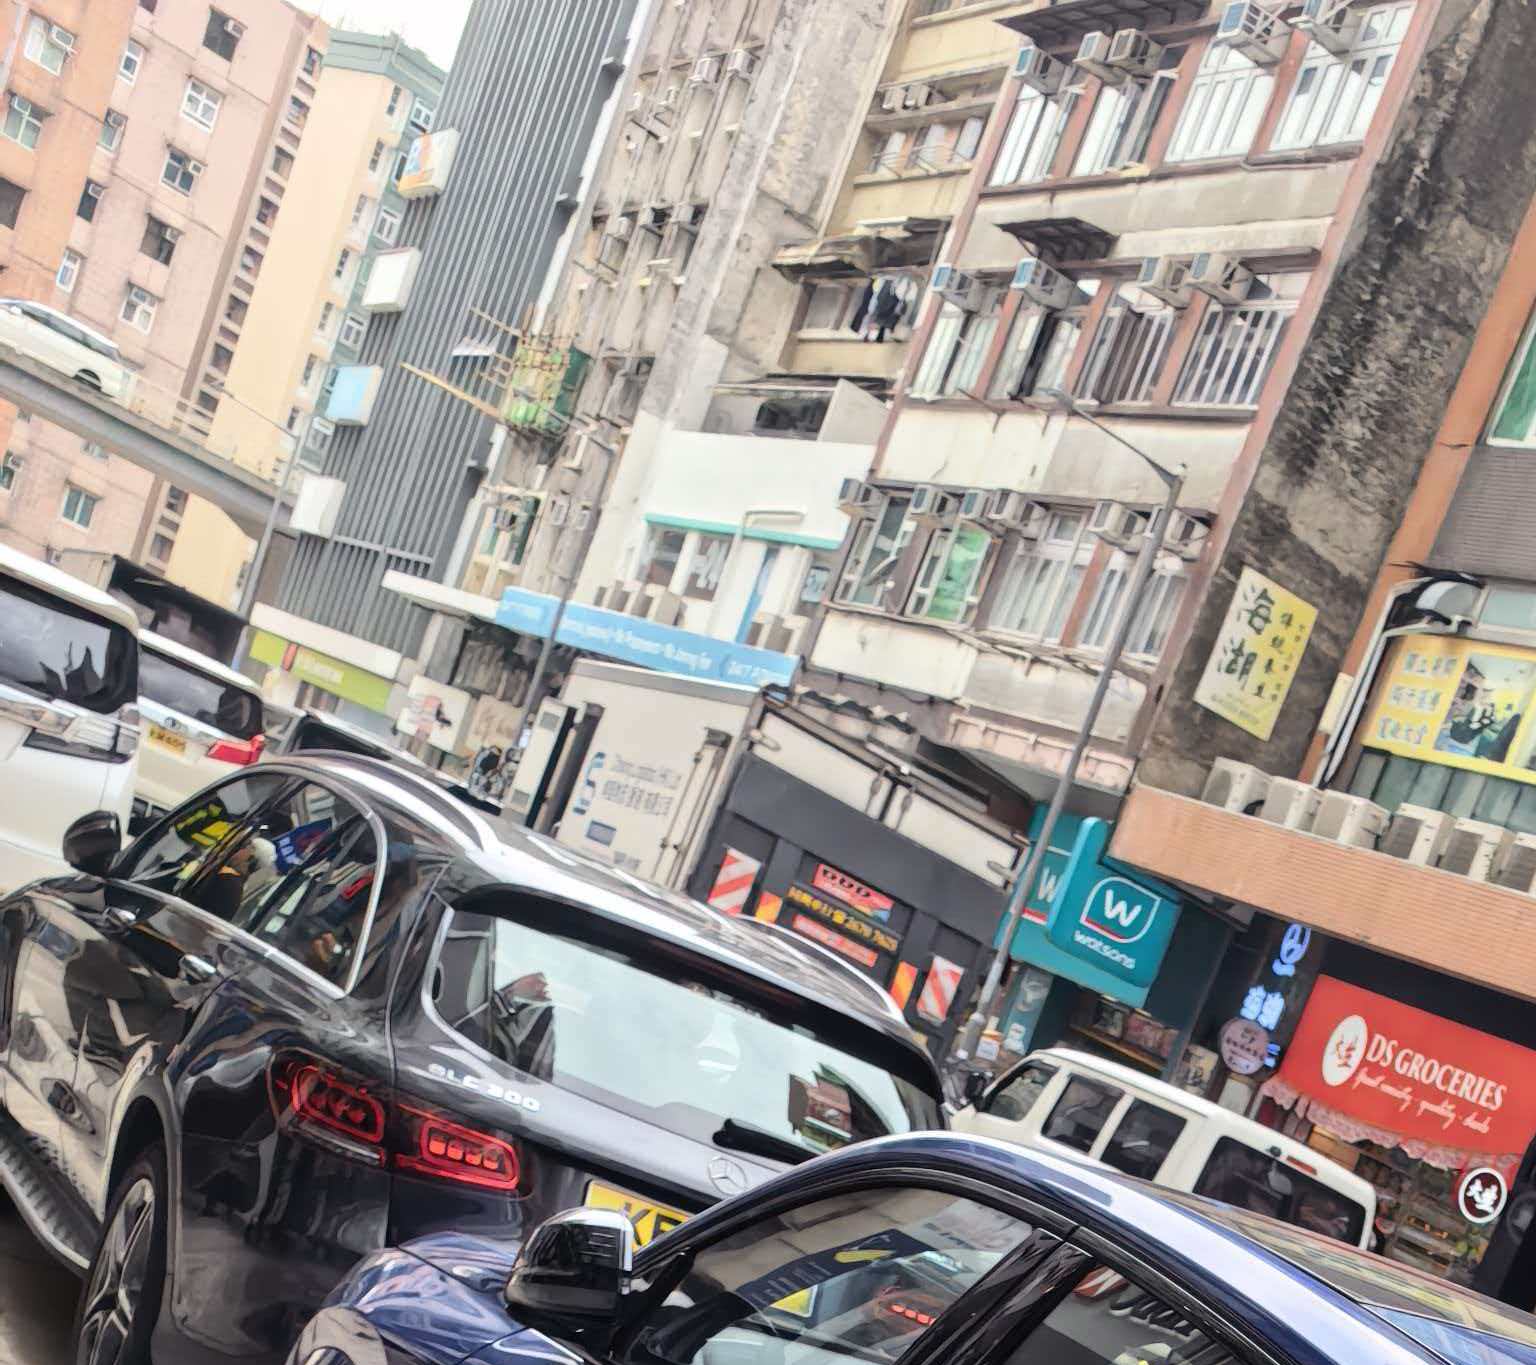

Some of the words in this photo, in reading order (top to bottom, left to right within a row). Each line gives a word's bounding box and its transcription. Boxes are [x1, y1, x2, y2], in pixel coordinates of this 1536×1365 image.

[1104, 888, 1142, 928] W
[1074, 930, 1136, 969] watsons
[1366, 1033, 1399, 1068] DS
[1394, 1048, 1508, 1111] GROCERIES
